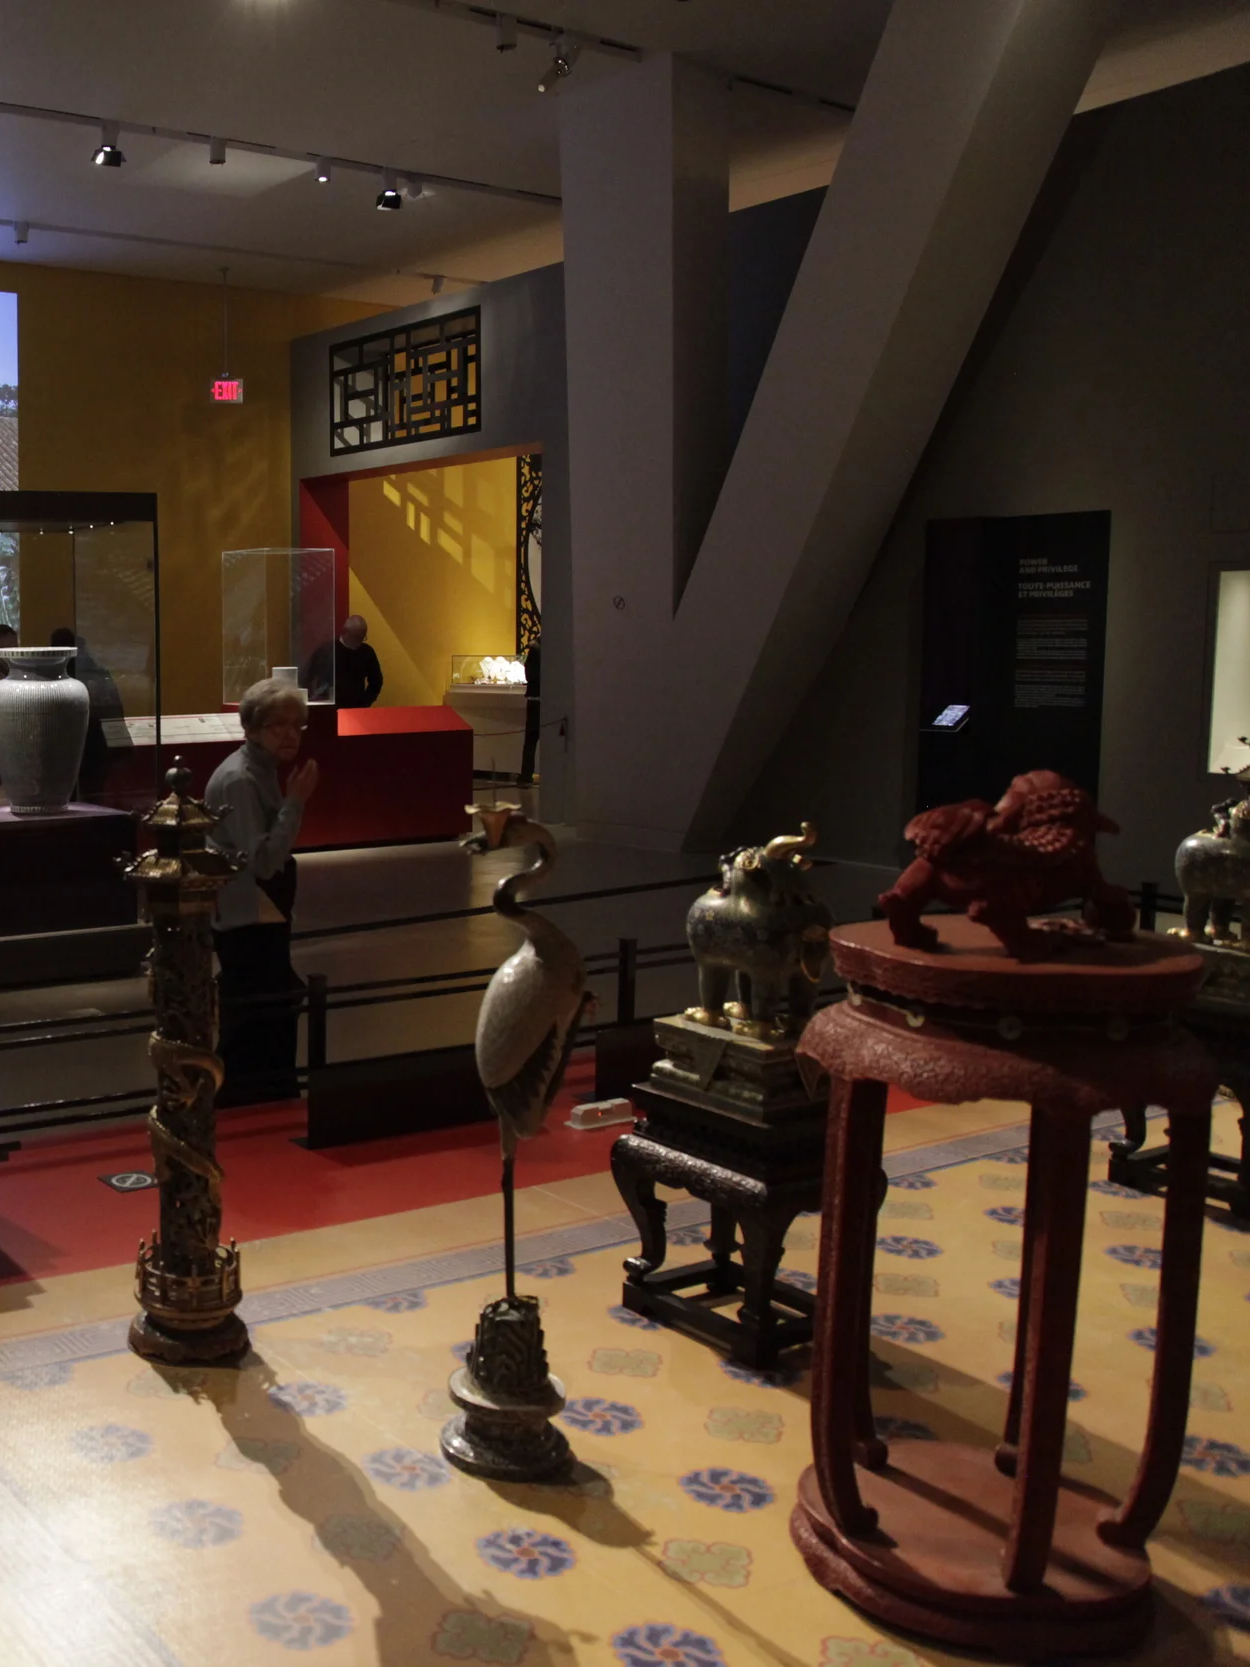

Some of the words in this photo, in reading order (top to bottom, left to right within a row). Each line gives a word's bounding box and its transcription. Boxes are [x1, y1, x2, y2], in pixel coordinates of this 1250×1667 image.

[214, 381, 239, 400] EXIT
[1019, 557, 1048, 565] POWER
[1018, 566, 1036, 574] AND
[1037, 565, 1078, 573] PRIVILEGE
[1018, 590, 1028, 598] ET
